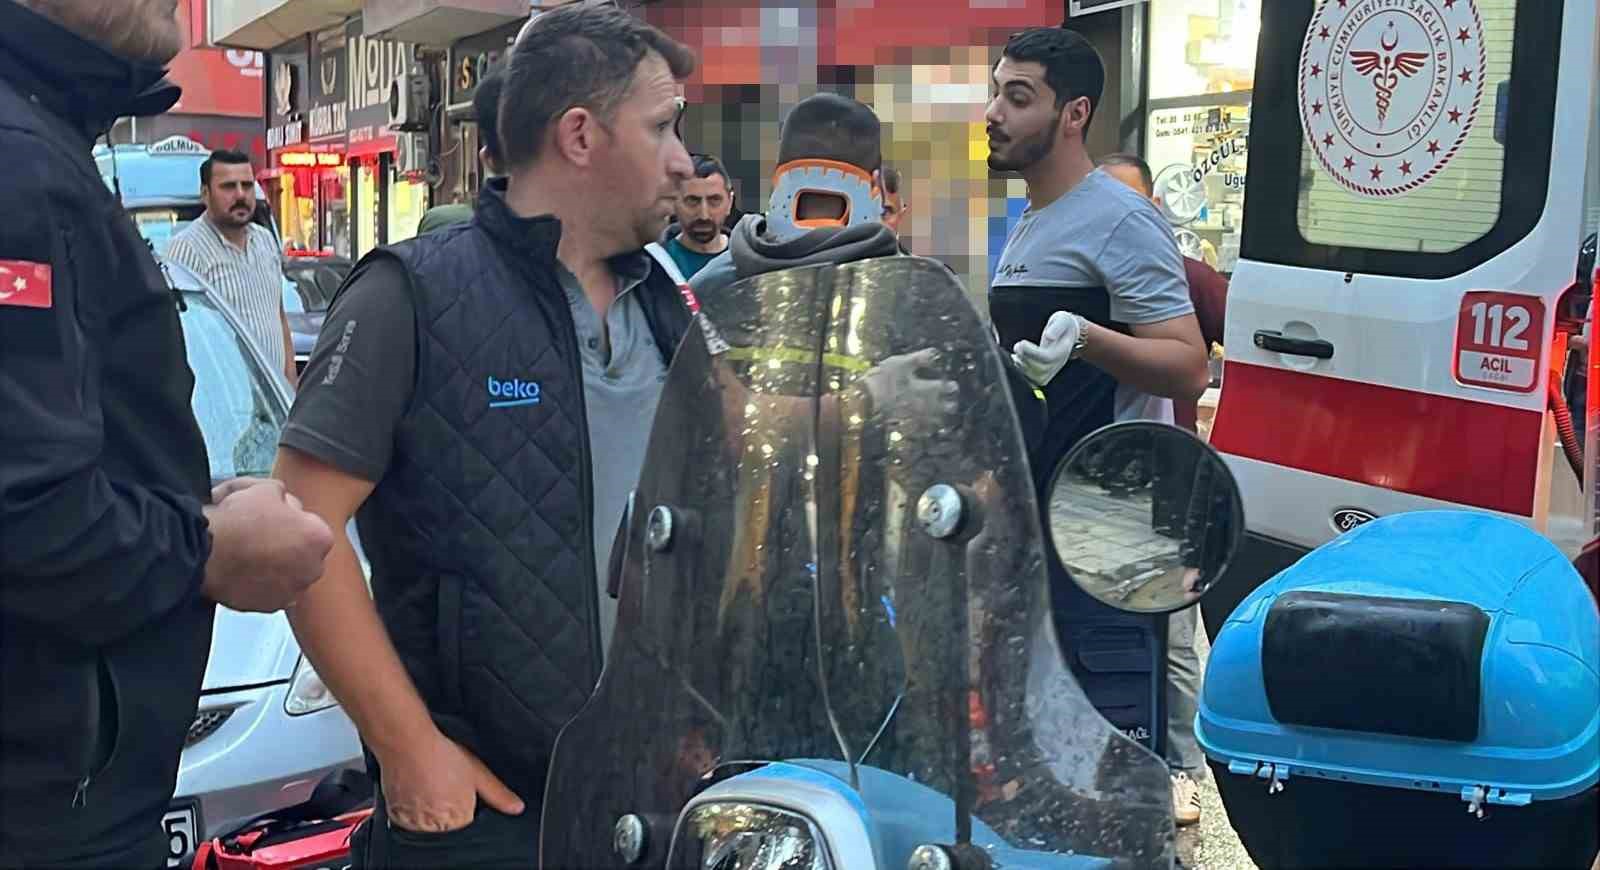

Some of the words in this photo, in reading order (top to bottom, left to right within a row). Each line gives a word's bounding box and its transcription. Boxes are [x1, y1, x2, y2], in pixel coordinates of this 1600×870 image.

[1191, 135, 1248, 182] ÖZGÜL-
[1471, 302, 1530, 351] 112
[487, 375, 540, 398] beko
